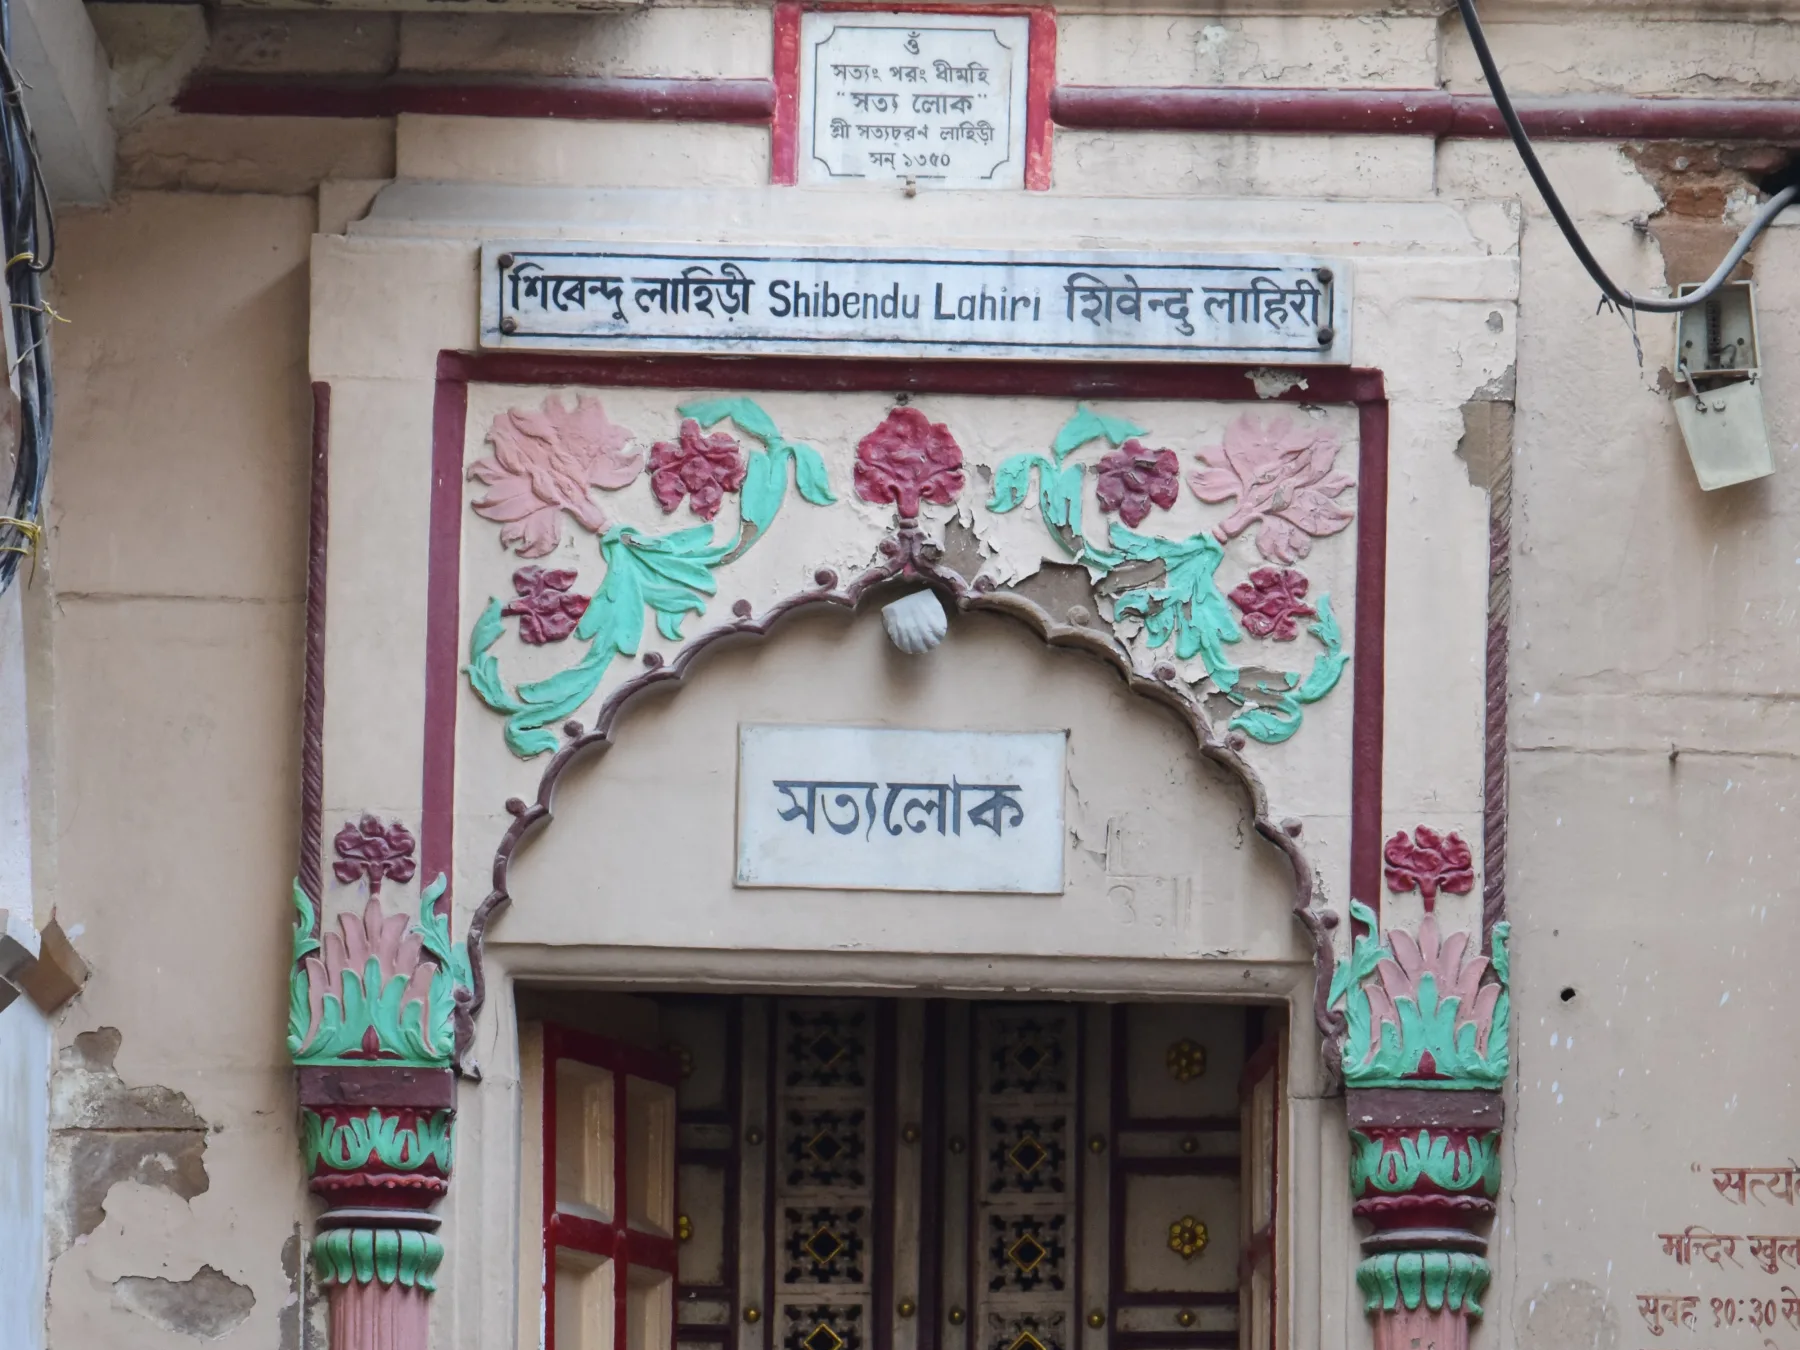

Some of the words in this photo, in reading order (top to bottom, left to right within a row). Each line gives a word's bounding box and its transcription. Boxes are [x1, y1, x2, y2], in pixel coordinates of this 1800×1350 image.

[830, 64, 882, 82] সত্যং
[889, 66, 928, 83] পরং
[932, 59, 990, 85] ধীমহি
[829, 117, 851, 139] শ্রী
[939, 120, 995, 146] লাহিড়ী
[902, 152, 950, 167] ১৩৫০
[508, 262, 628, 323] শিবেন্দু
[631, 262, 755, 322] লাহিড়ী
[768, 279, 920, 321] Shibendu
[934, 282, 1041, 322] Lahiri
[1063, 272, 1195, 336] शिवेन्दु
[1202, 276, 1322, 330] लाहिरी
[772, 774, 1024, 842] সত্যলোক
